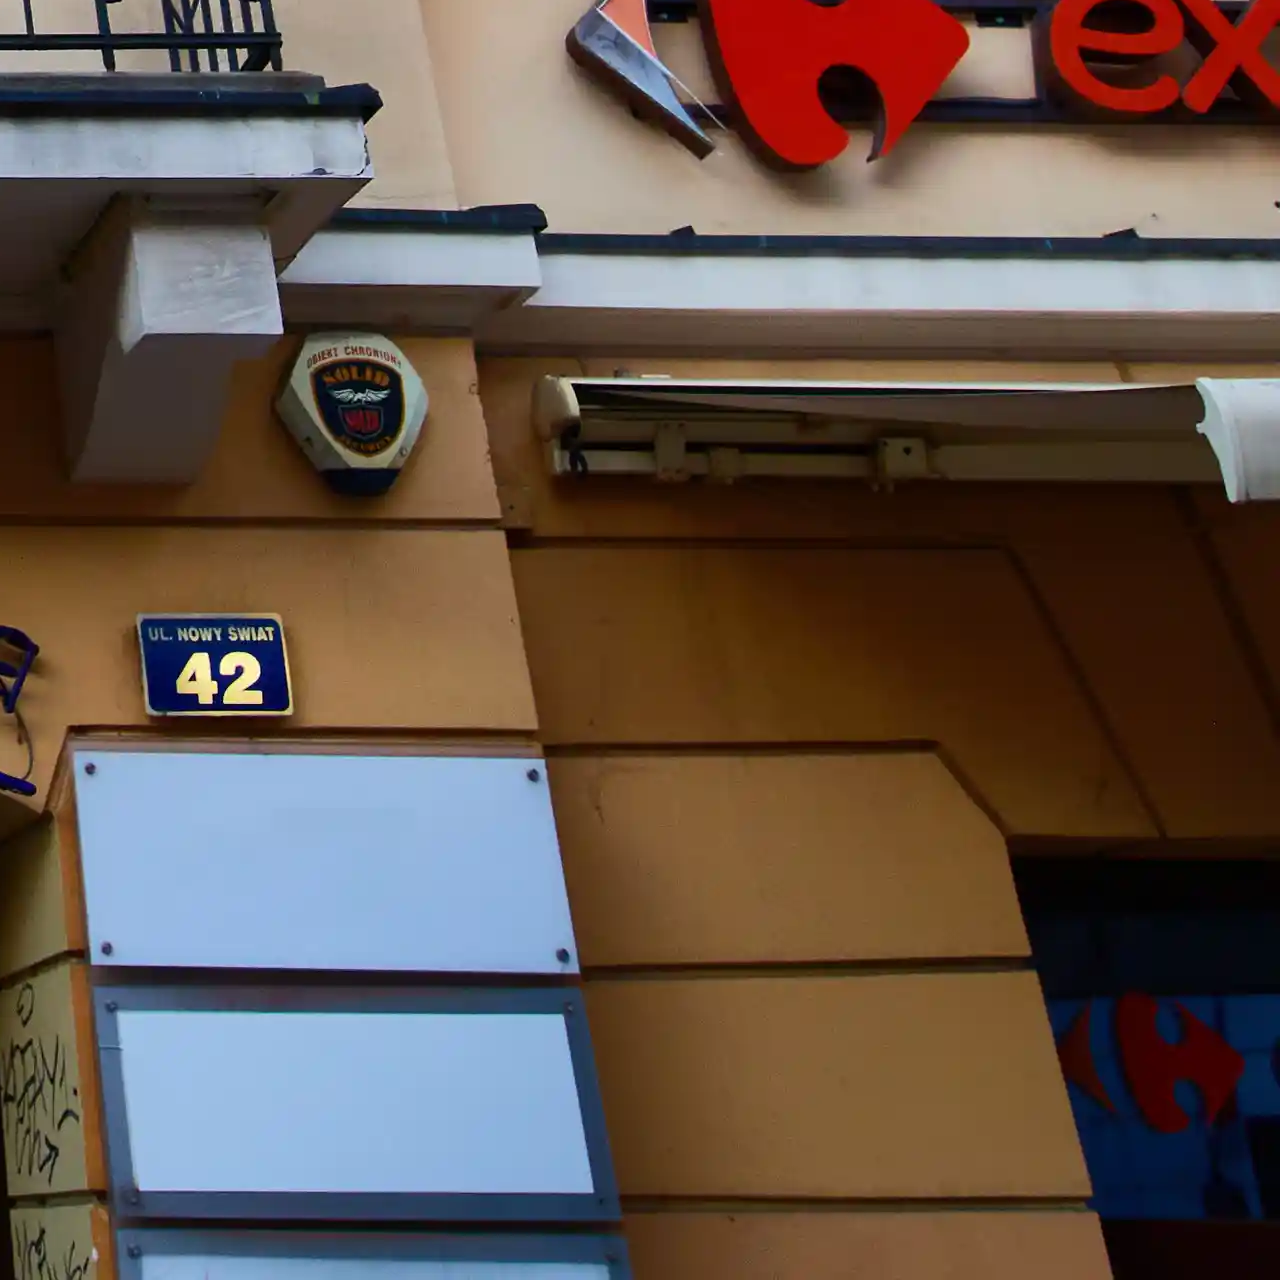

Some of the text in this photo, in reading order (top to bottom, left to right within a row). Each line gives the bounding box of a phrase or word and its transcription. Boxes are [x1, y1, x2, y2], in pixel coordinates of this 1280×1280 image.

[322, 365, 391, 388] SOLID
[148, 627, 173, 641] UL.
[177, 627, 223, 642] NOWY
[176, 651, 263, 705] 42
